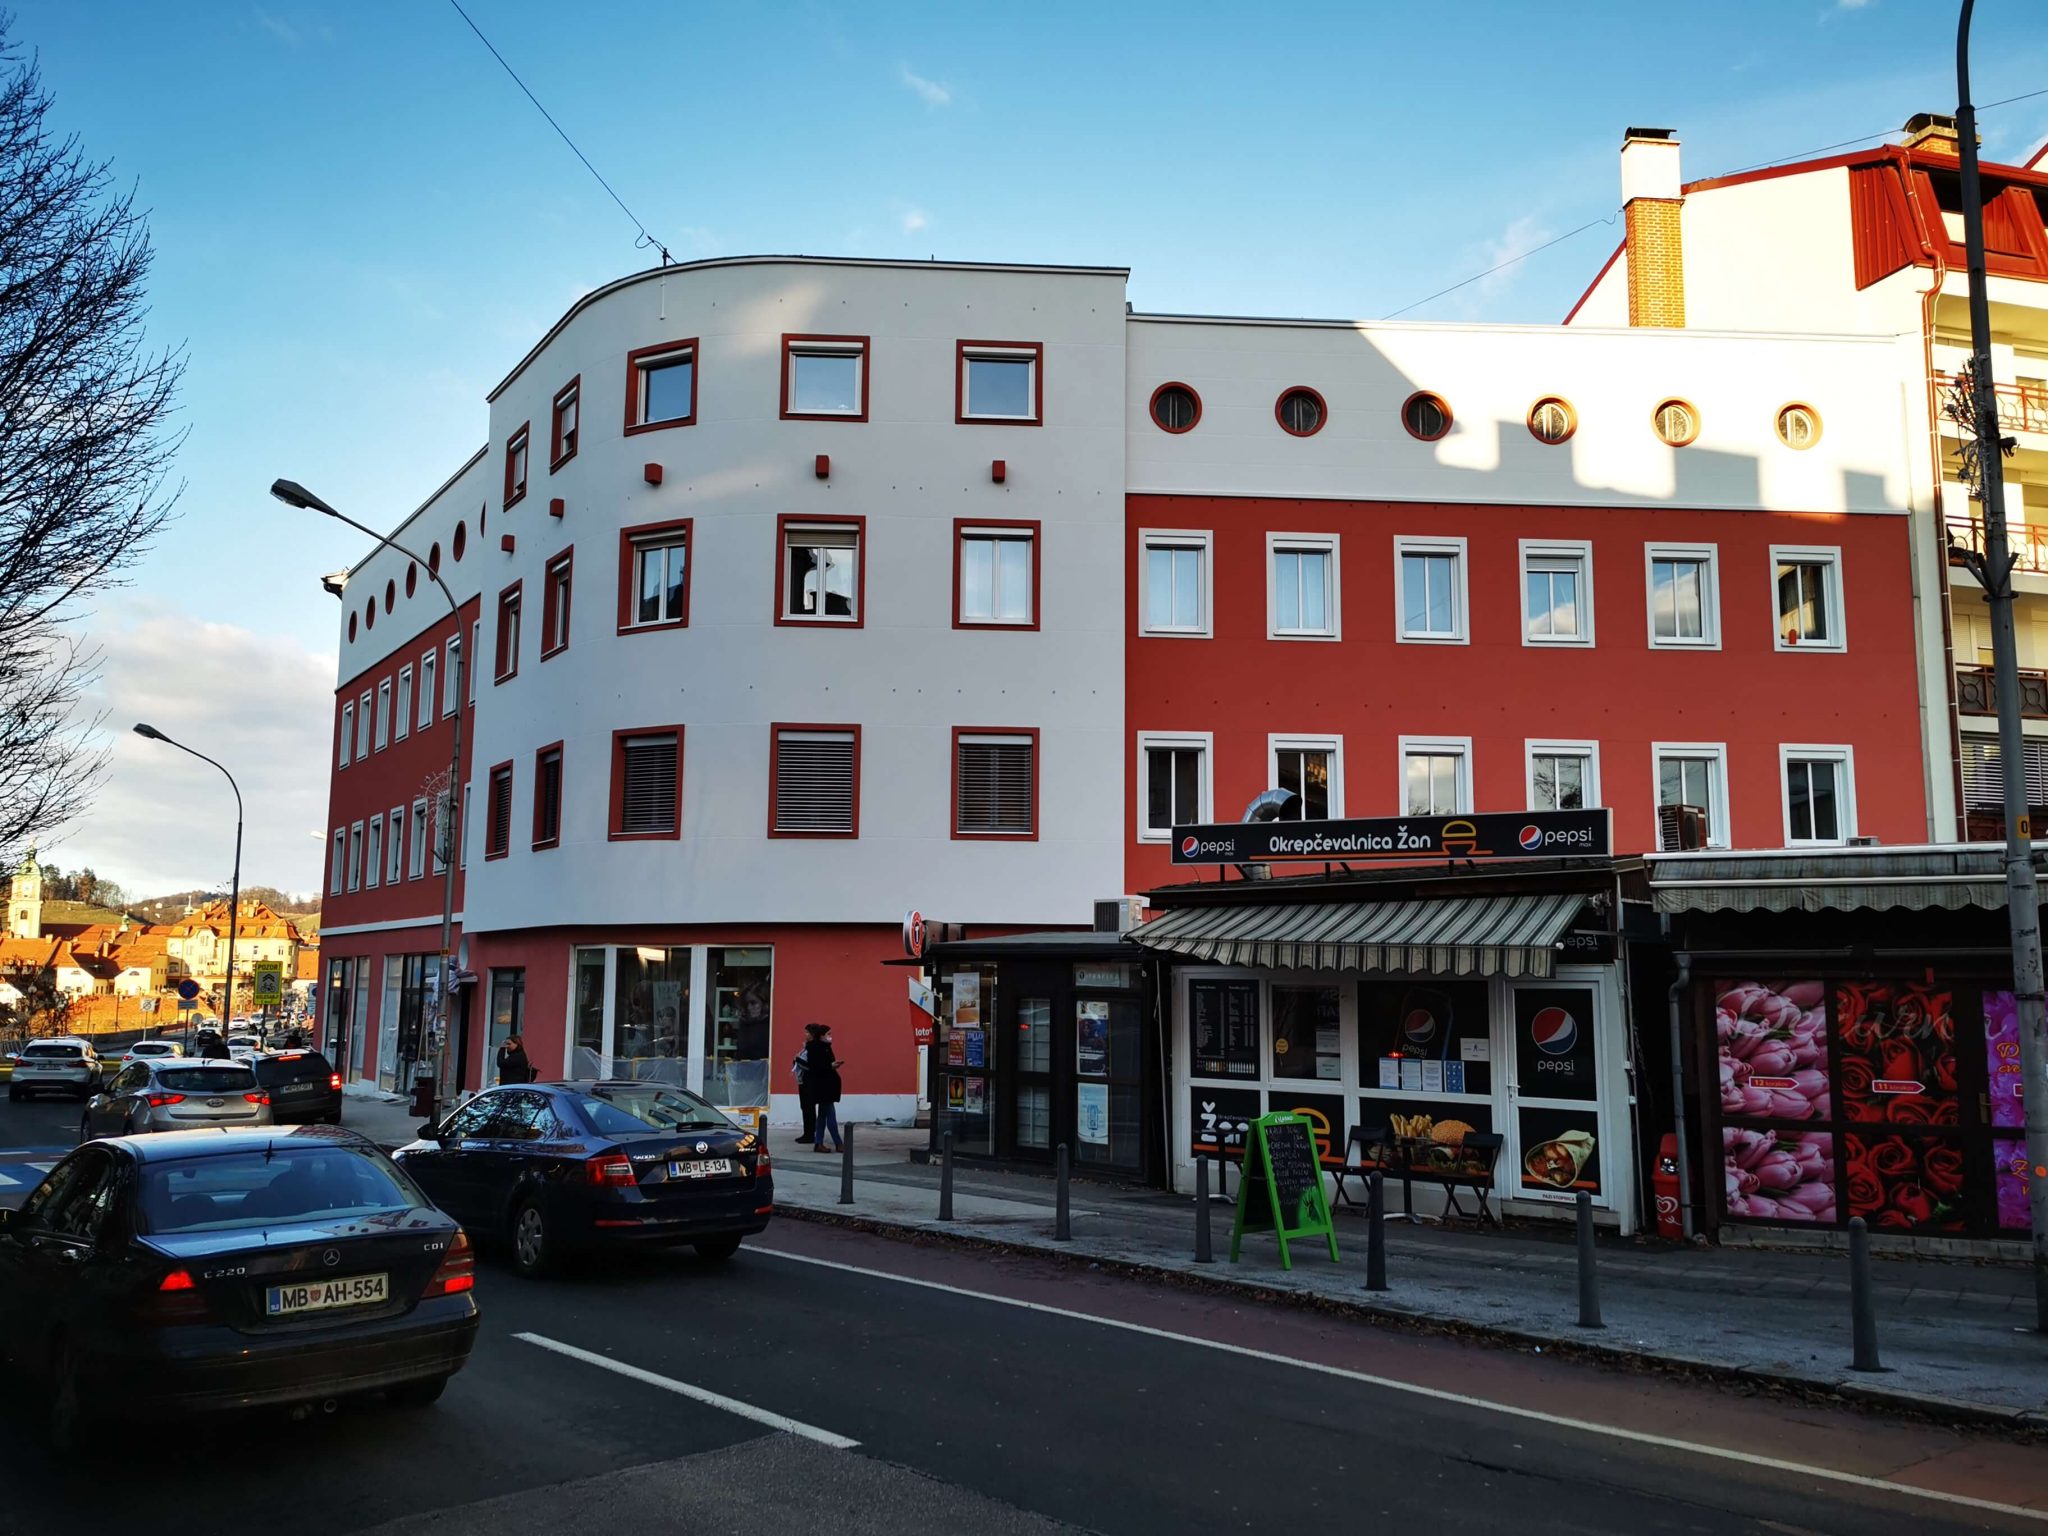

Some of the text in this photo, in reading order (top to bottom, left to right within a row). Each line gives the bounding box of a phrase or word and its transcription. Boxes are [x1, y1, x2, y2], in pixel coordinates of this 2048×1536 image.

[1269, 825, 1431, 855] Okrepčevalnica Žan
[1544, 827, 1592, 847] pepsi
[1200, 838, 1235, 855] pepsi
[1402, 1043, 1428, 1057] pepsi
[1537, 1059, 1574, 1073] pepsi
[1754, 1079, 1764, 1087] 12
[1878, 1082, 1888, 1090] 11
[678, 1160, 727, 1174] MB LE-134
[423, 1242, 444, 1251] CDI
[215, 1265, 246, 1278] 220
[282, 1278, 384, 1310] MB AH-554
